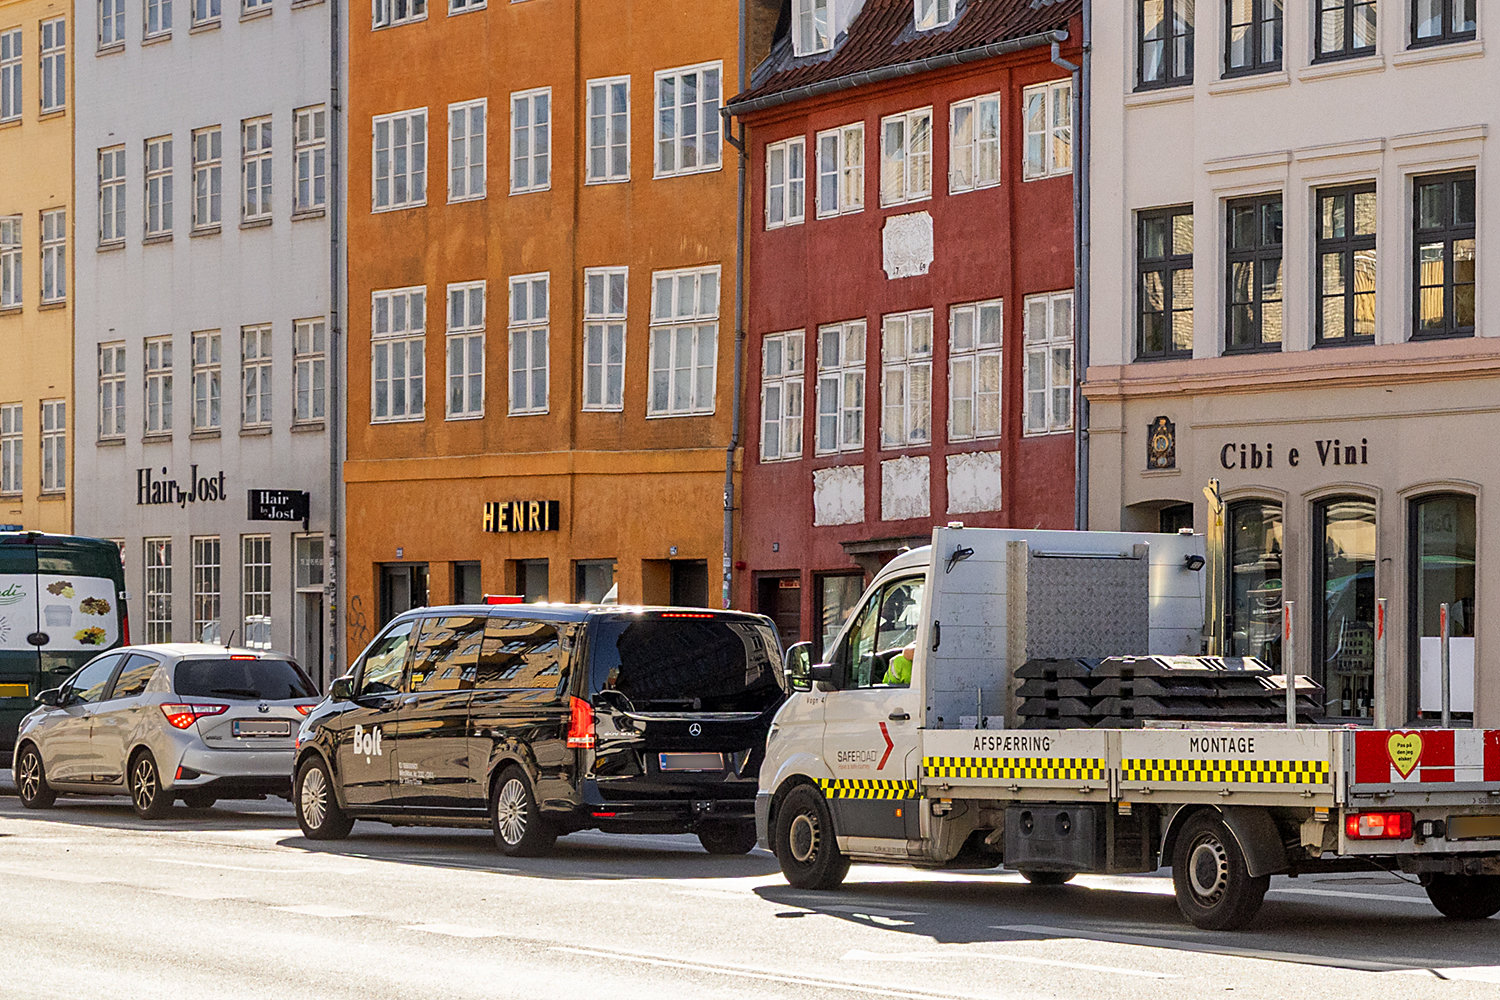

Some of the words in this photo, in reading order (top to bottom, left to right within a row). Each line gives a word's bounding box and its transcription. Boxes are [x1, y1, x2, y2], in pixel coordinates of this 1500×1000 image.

[1220, 443, 1273, 469] Cibi
[1288, 448, 1299, 467] e
[1315, 438, 1368, 466] Vini
[137, 467, 176, 505] Hair
[177, 486, 186, 509] by
[188, 465, 226, 503] Jost
[260, 492, 289, 506] Hair
[268, 506, 295, 520] Jost
[483, 501, 550, 533] HENRI
[354, 724, 382, 764] Bolt
[973, 736, 1050, 752] AFSPÆRRING
[1190, 737, 1255, 753] MONTAGE
[838, 751, 877, 763] SAFEROAD
